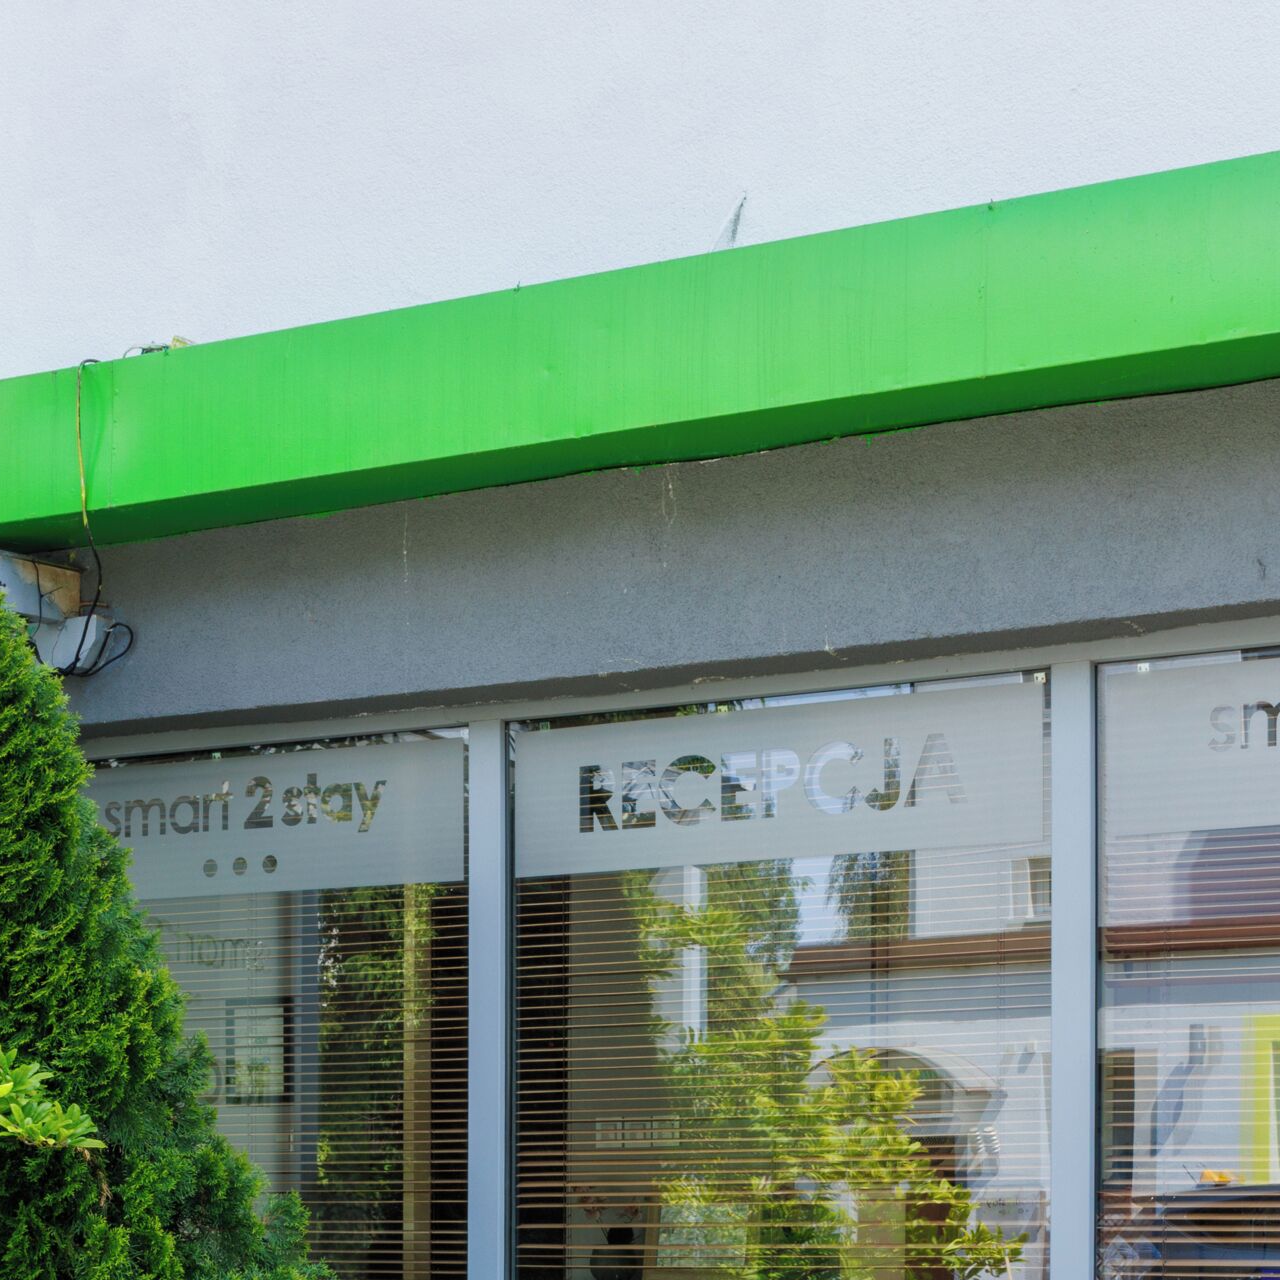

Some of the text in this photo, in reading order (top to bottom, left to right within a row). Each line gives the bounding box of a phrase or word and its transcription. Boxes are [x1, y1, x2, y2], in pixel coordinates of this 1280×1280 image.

[104, 772, 388, 839] smart 2 stay
[578, 732, 969, 834] RECEPCJA
